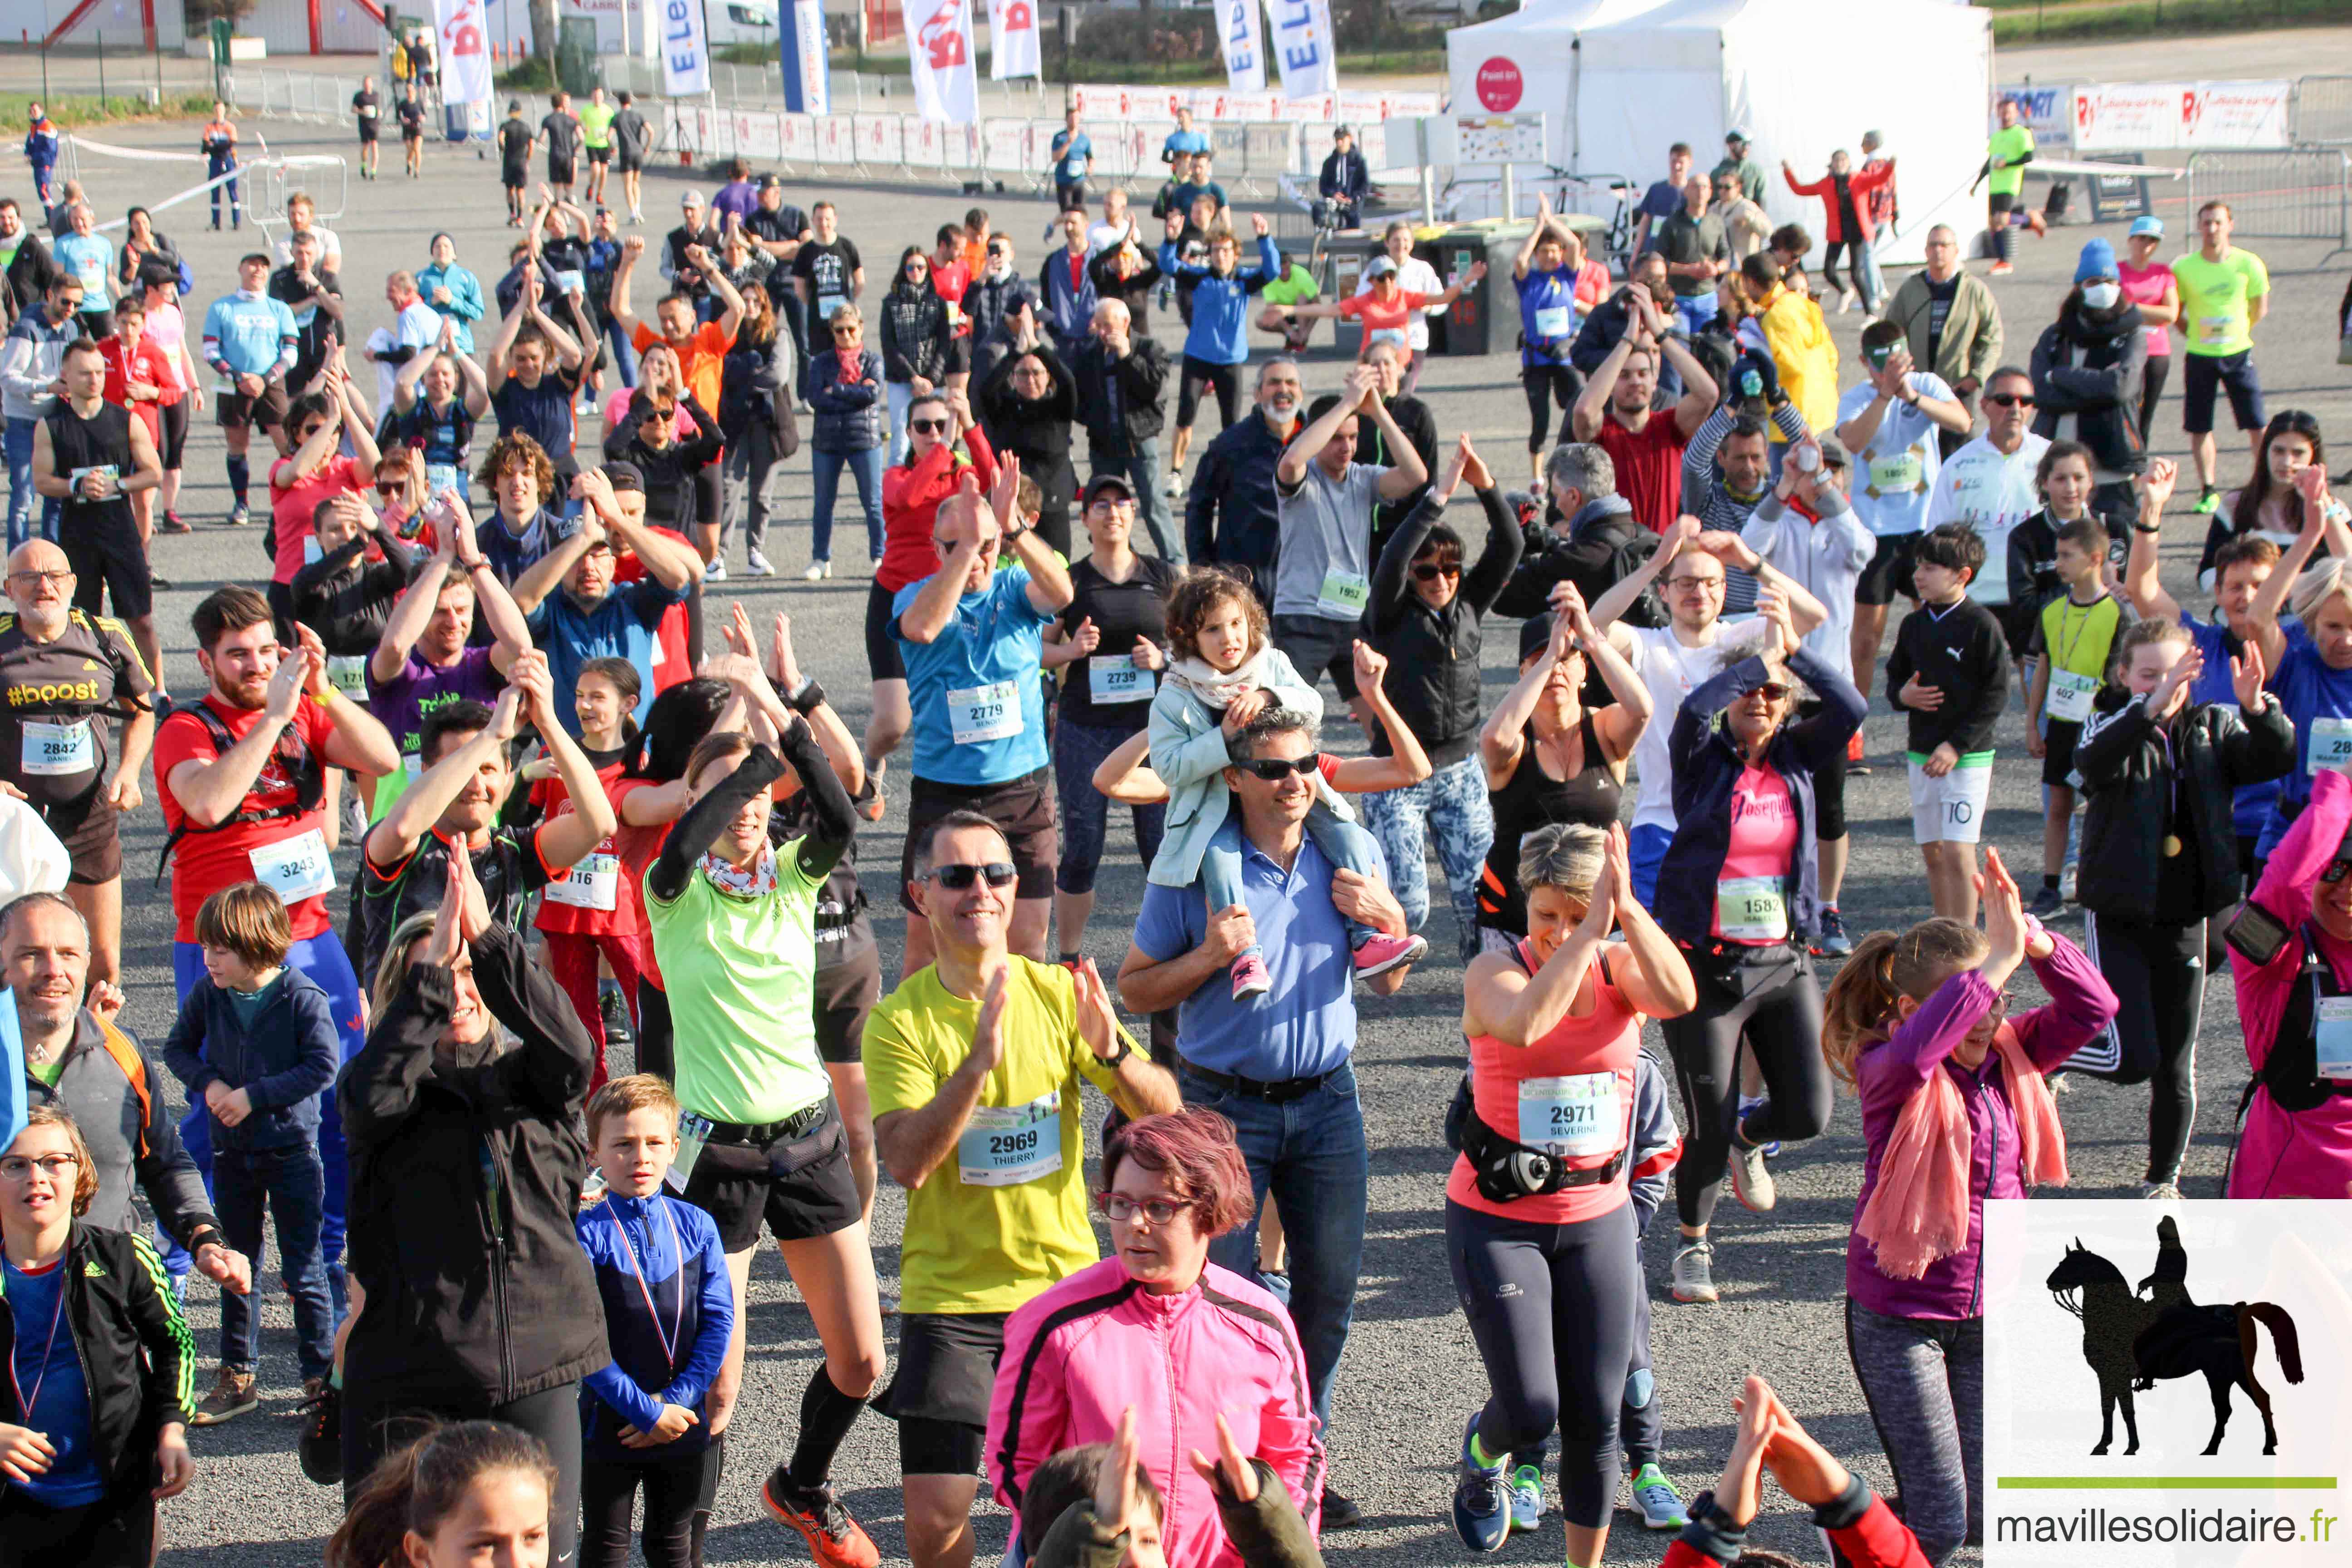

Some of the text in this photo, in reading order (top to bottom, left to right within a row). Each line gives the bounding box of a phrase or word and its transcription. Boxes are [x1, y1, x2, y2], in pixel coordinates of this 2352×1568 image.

[1107, 671, 1137, 684] 2739
[7, 679, 99, 707] #boost
[2056, 687, 2075, 700] 402
[970, 704, 1003, 720] 2779
[44, 742, 77, 755] 2842
[1948, 800, 1971, 823] 10
[281, 856, 315, 878] 3243
[1744, 899, 1779, 914] 1582
[1551, 1104, 1594, 1124] 2971
[1551, 1125, 1597, 1136] SEVERINE
[990, 1130, 1037, 1153] 2969
[993, 1151, 1036, 1166] THIERRY
